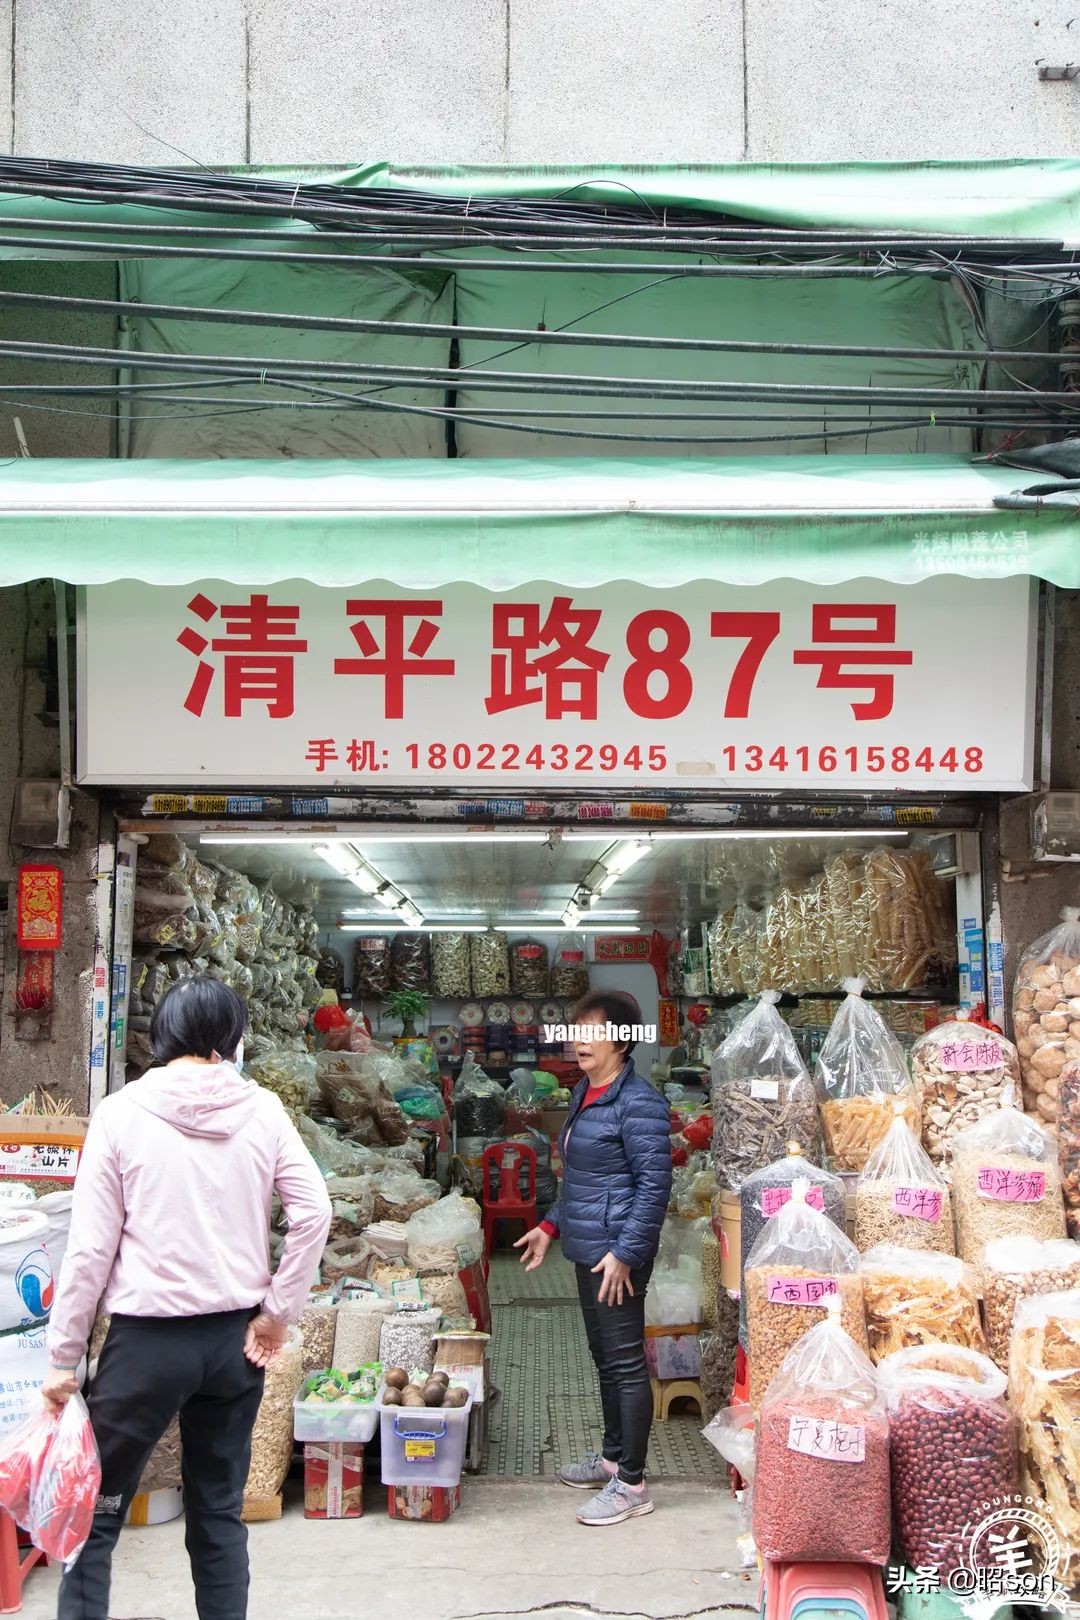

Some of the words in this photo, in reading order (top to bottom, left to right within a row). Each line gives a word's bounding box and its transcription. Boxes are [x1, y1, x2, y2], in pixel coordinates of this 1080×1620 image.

[178, 595, 912, 720] 清平路87号
[406, 743, 667, 771] 18022432945
[723, 745, 983, 772] 13416158448
